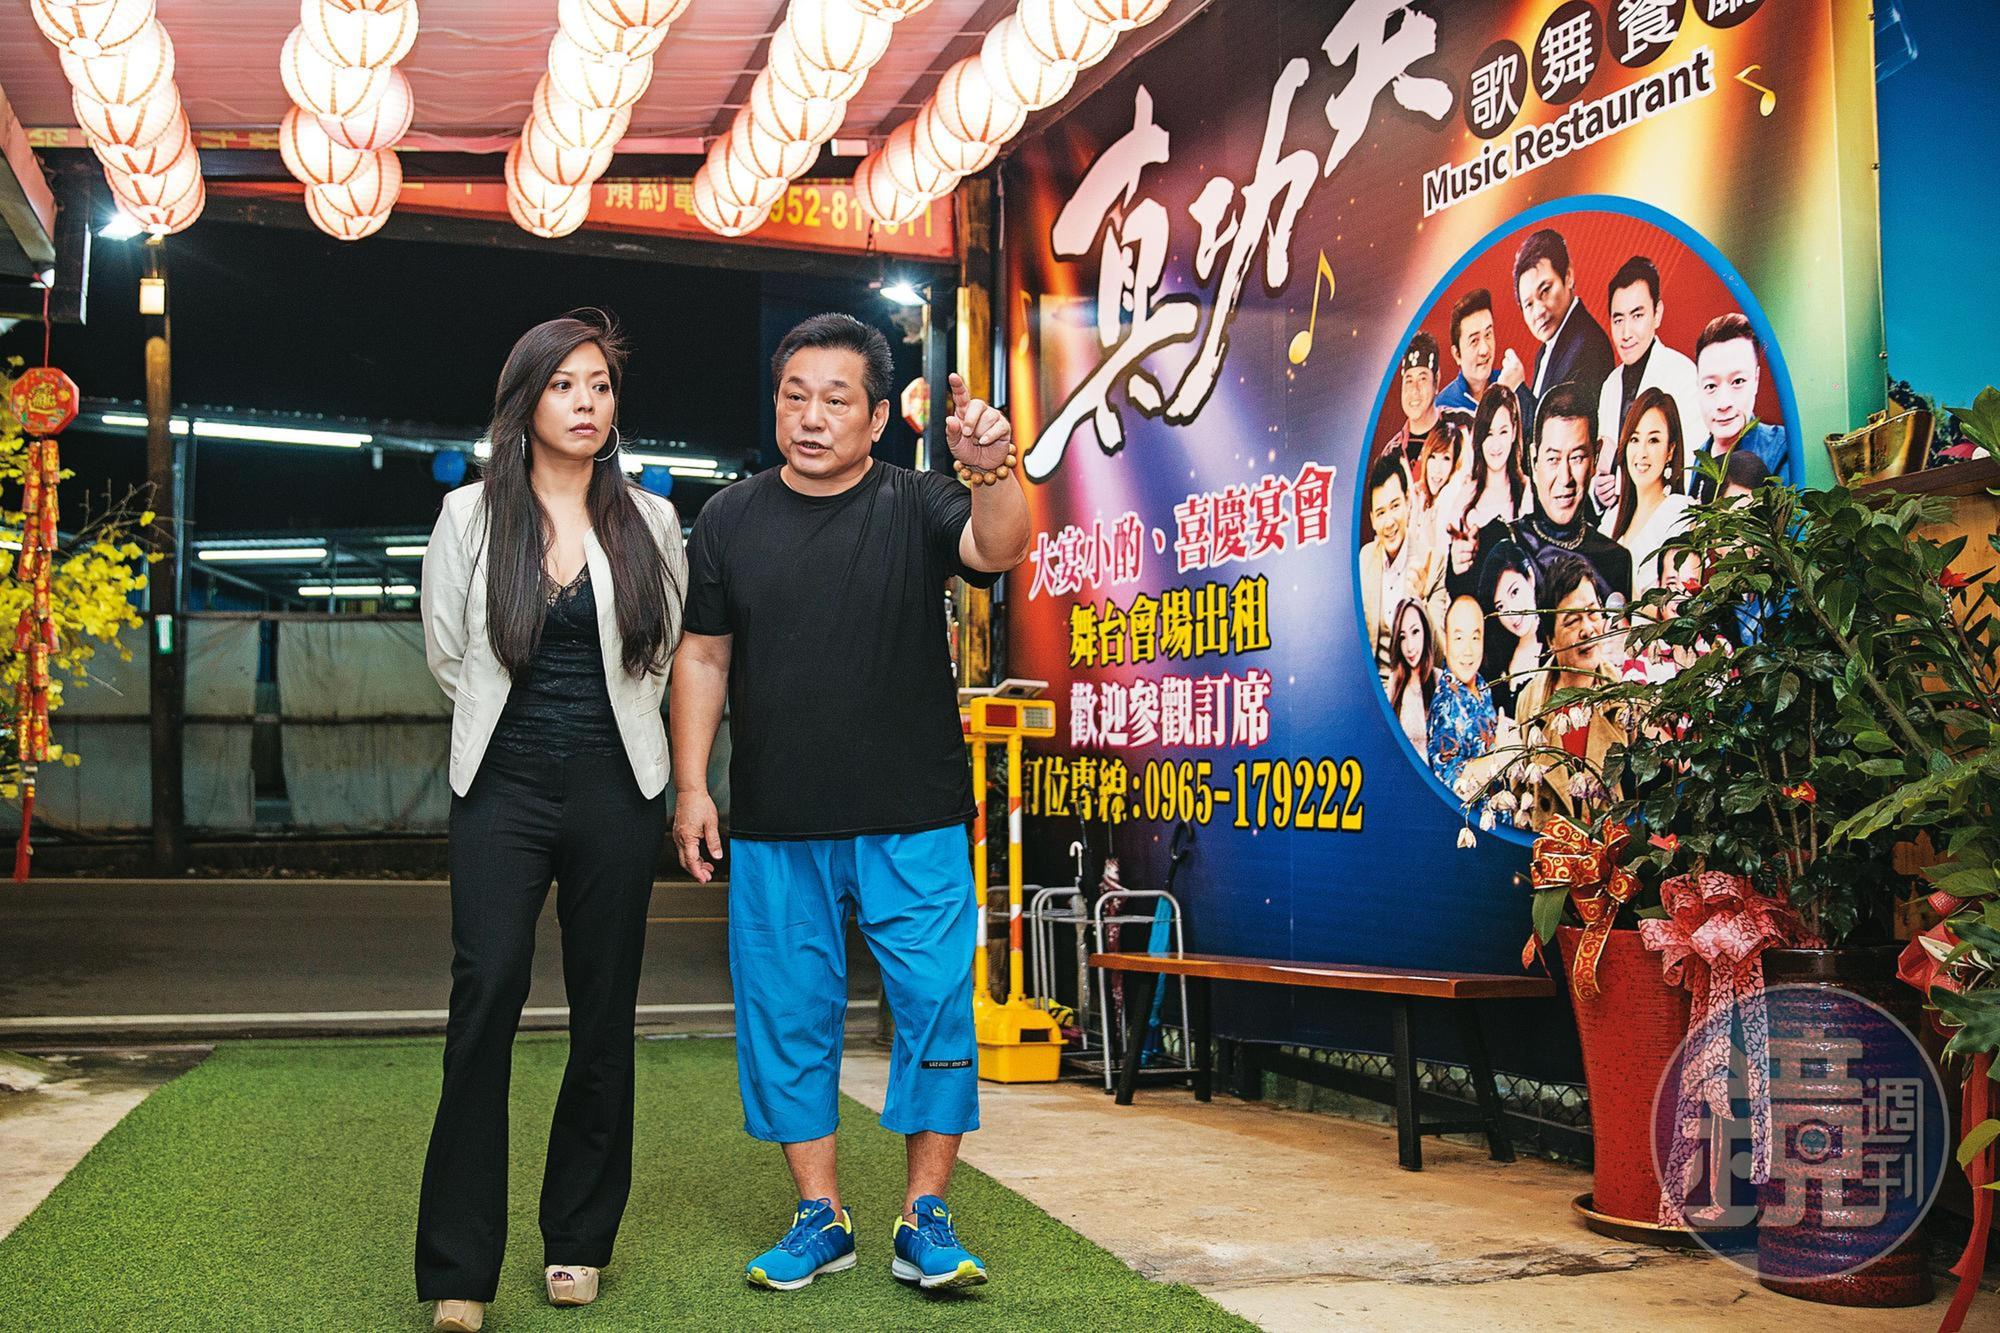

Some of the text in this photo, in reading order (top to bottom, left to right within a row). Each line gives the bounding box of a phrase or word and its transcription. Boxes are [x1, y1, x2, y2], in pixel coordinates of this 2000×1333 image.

[1424, 48, 1714, 214] Music Restaurant
[1070, 574, 1271, 666] 舞台會場出租
[1070, 671, 1271, 748] 歡迎參觀訂席
